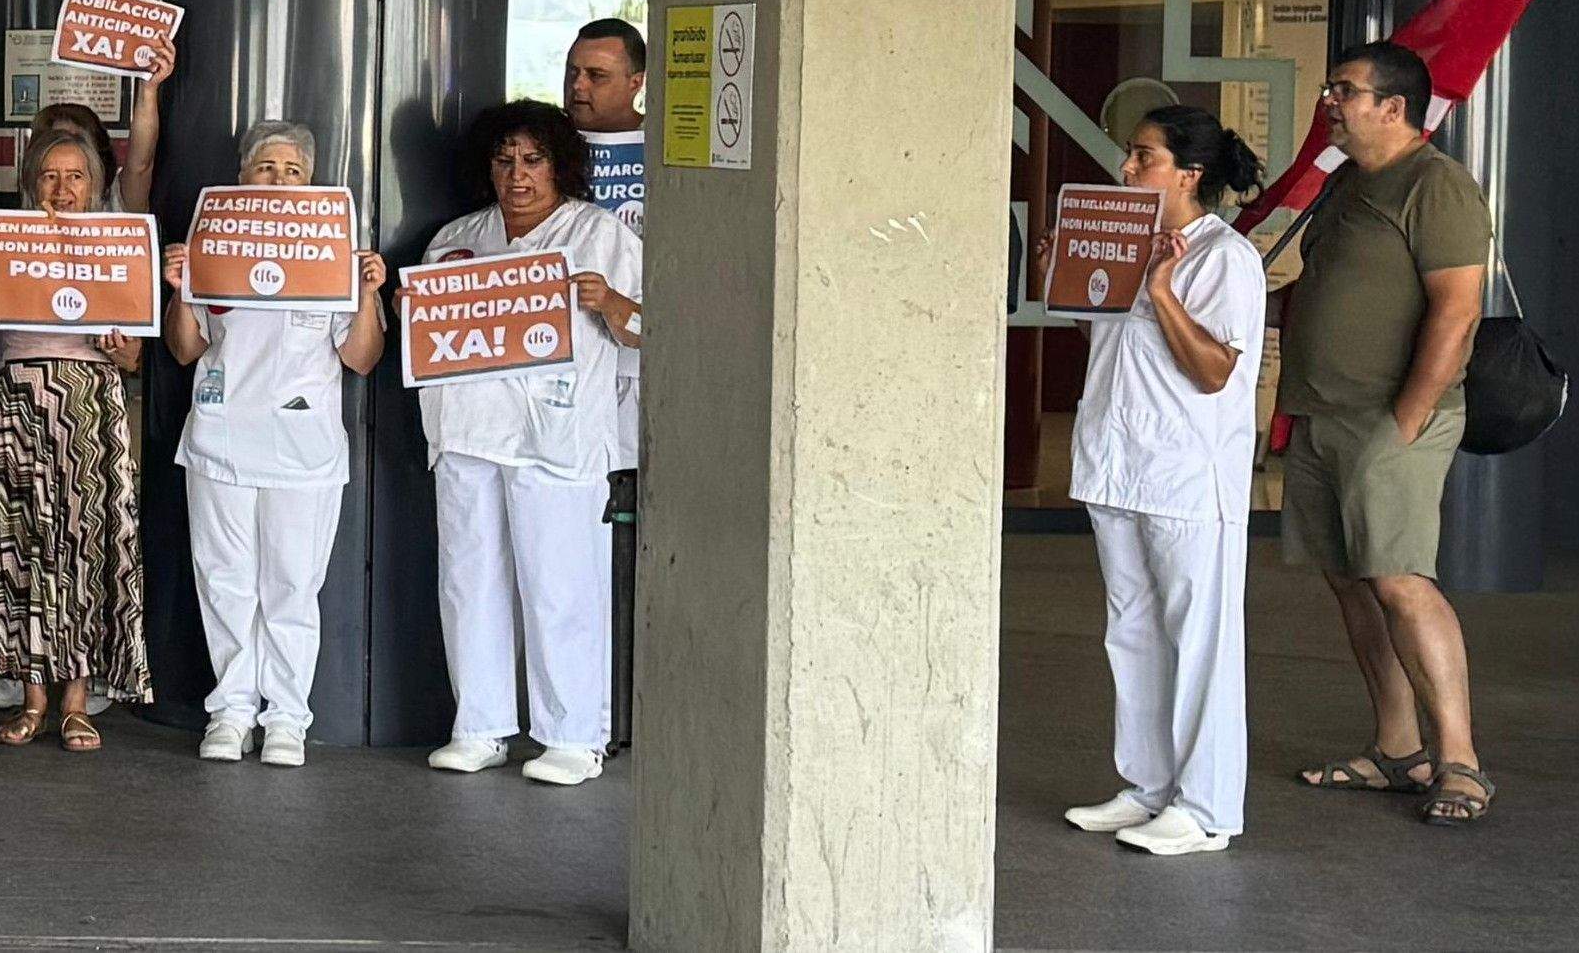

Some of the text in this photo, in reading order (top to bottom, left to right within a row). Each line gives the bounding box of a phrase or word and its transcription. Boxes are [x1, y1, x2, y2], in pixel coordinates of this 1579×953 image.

[71, 30, 124, 60] XA!
[593, 163, 644, 177] MARC
[203, 197, 345, 215] CLASIFICACIÓN
[22, 224, 100, 237] MELLORAS
[102, 226, 146, 237] REAIS
[197, 218, 346, 238] PROFESIONAL
[1101, 220, 1149, 235] REFORMA
[32, 242, 61, 253] HAI
[64, 245, 146, 257] REFORMA
[202, 239, 335, 261] RETRIBUÍDA
[1068, 239, 1137, 263] POSIBLE
[10, 260, 128, 282] POSIBLE
[412, 261, 563, 296] XUBILACIÓN
[412, 293, 566, 323] ANTICIPADA
[429, 326, 506, 364] XA!
